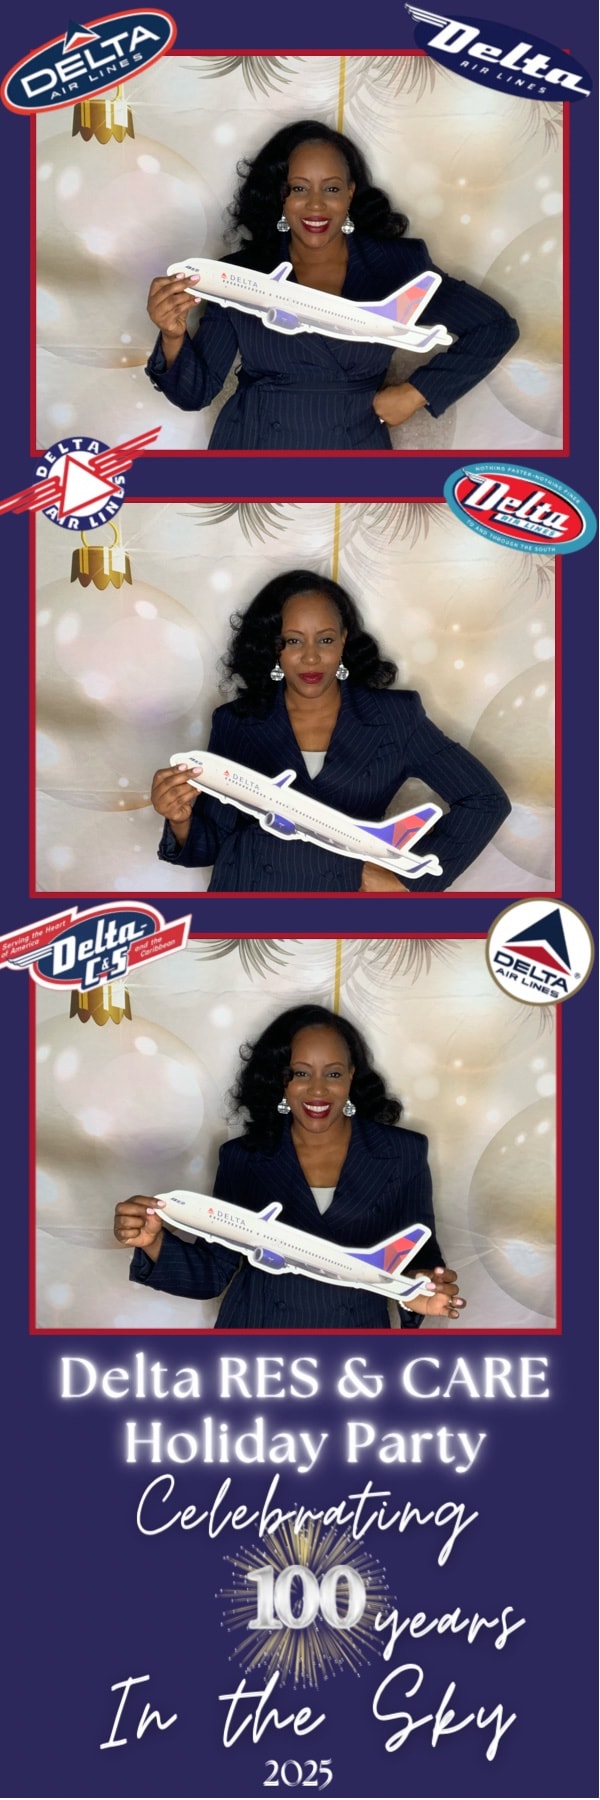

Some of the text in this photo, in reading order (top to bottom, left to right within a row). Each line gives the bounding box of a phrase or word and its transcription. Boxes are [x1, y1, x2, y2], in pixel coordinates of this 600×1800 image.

[230, 274, 259, 288] DELTA
[232, 773, 260, 791] DELTA
[217, 1210, 247, 1226] DELTA
